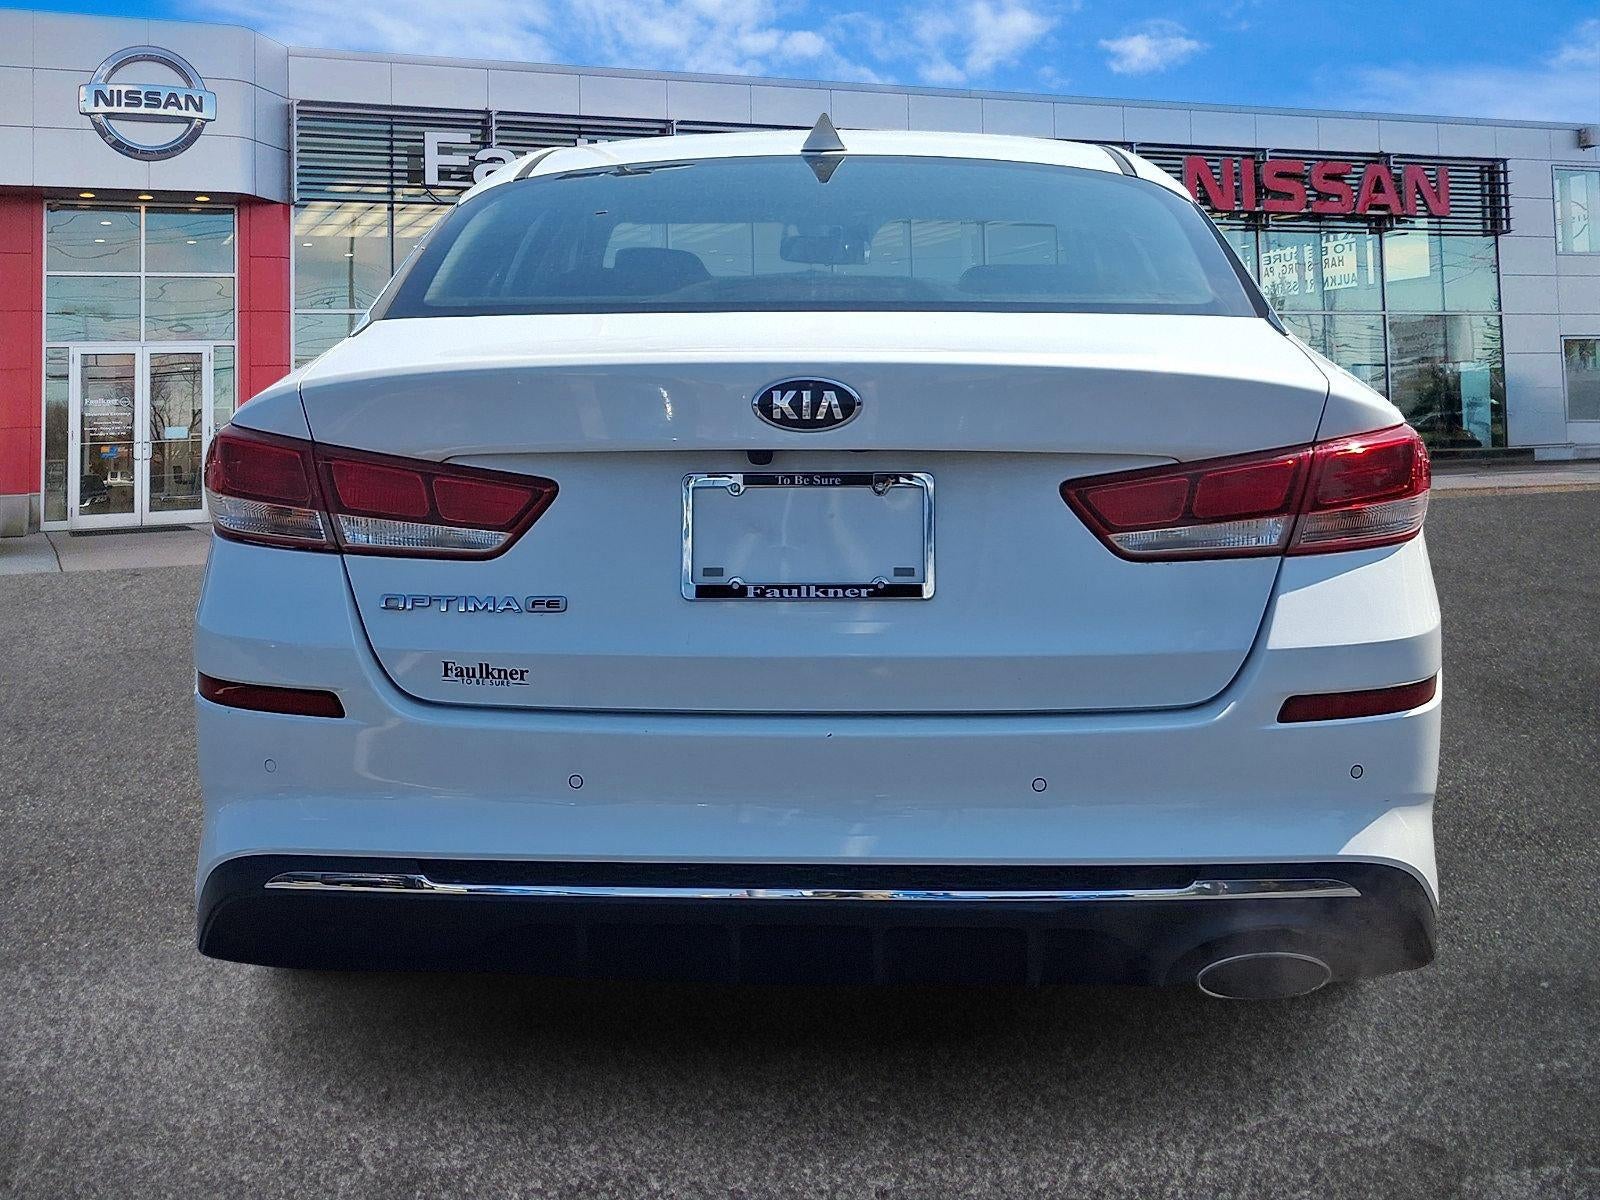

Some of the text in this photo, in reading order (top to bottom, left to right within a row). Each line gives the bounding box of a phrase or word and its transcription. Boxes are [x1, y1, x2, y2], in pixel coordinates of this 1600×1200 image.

[93, 89, 204, 113] NISSAN
[1184, 155, 1449, 216] NISSAN
[771, 390, 843, 420] KIA
[775, 475, 842, 486] To Be Sure
[746, 585, 875, 598] Faulkner
[379, 593, 563, 614] OPTIMA FE
[441, 660, 530, 681] Faulkner
[461, 678, 511, 688] TO BE SURE
